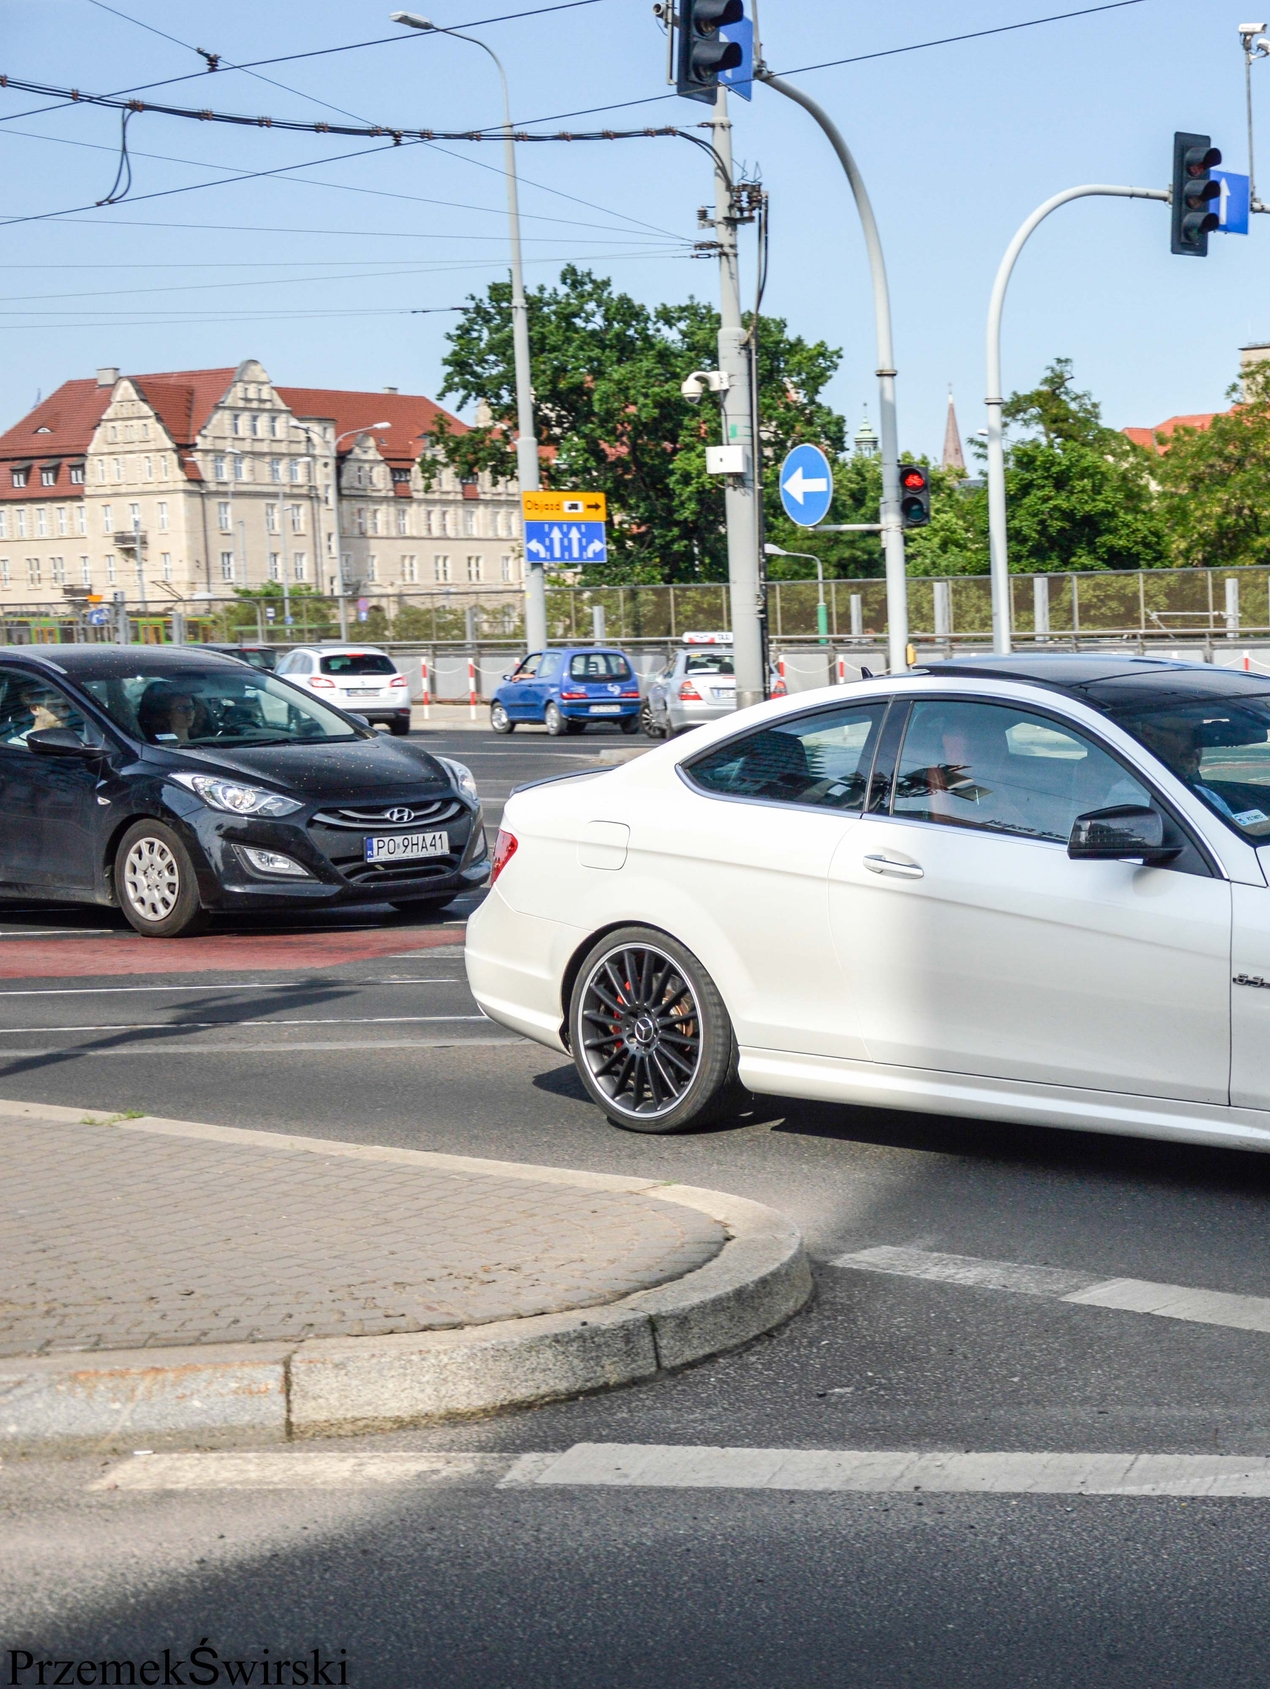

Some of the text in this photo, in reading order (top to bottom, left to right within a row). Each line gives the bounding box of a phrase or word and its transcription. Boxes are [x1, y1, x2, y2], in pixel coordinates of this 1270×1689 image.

[525, 500, 560, 513] Objazd
[376, 833, 444, 856] PO 9HA41
